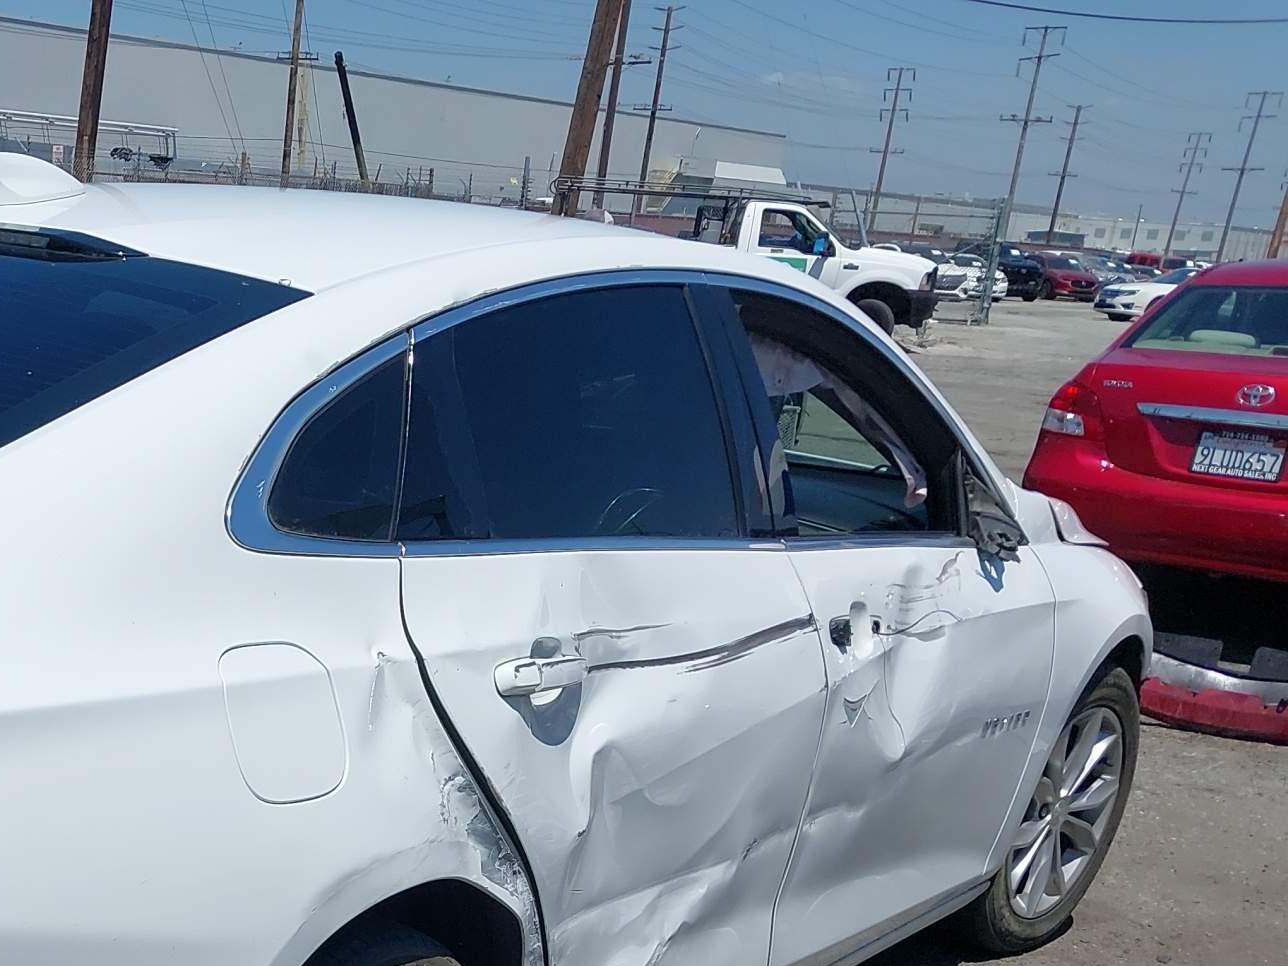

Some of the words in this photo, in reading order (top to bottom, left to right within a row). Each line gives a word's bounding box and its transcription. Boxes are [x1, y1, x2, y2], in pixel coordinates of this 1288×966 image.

[1192, 463, 1209, 472] NEXT
[1208, 464, 1227, 475] GEAR
[1226, 467, 1243, 477] AUTO
